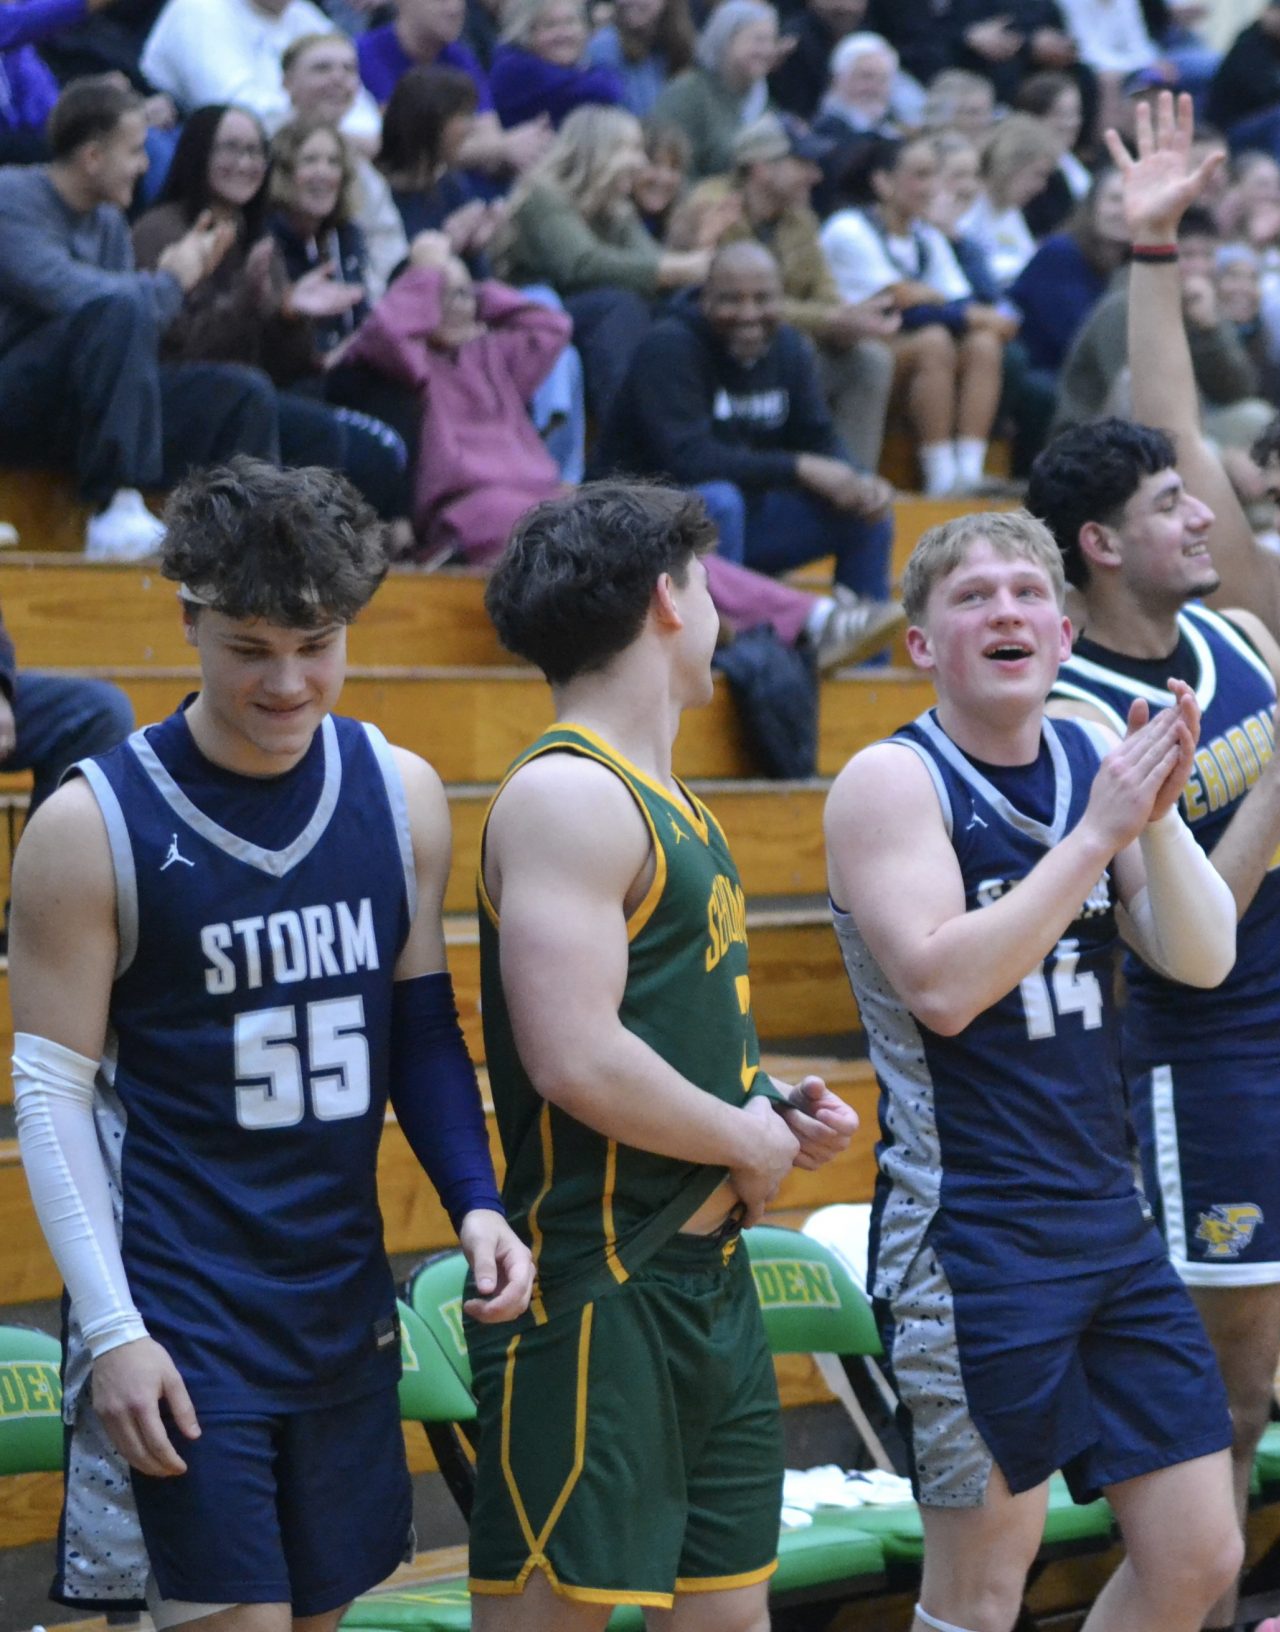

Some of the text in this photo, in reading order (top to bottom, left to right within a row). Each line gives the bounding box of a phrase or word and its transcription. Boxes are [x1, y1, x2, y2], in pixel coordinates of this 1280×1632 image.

[200, 897, 380, 995] STORM
[1020, 938, 1104, 1041] 14
[234, 994, 371, 1131] 55
